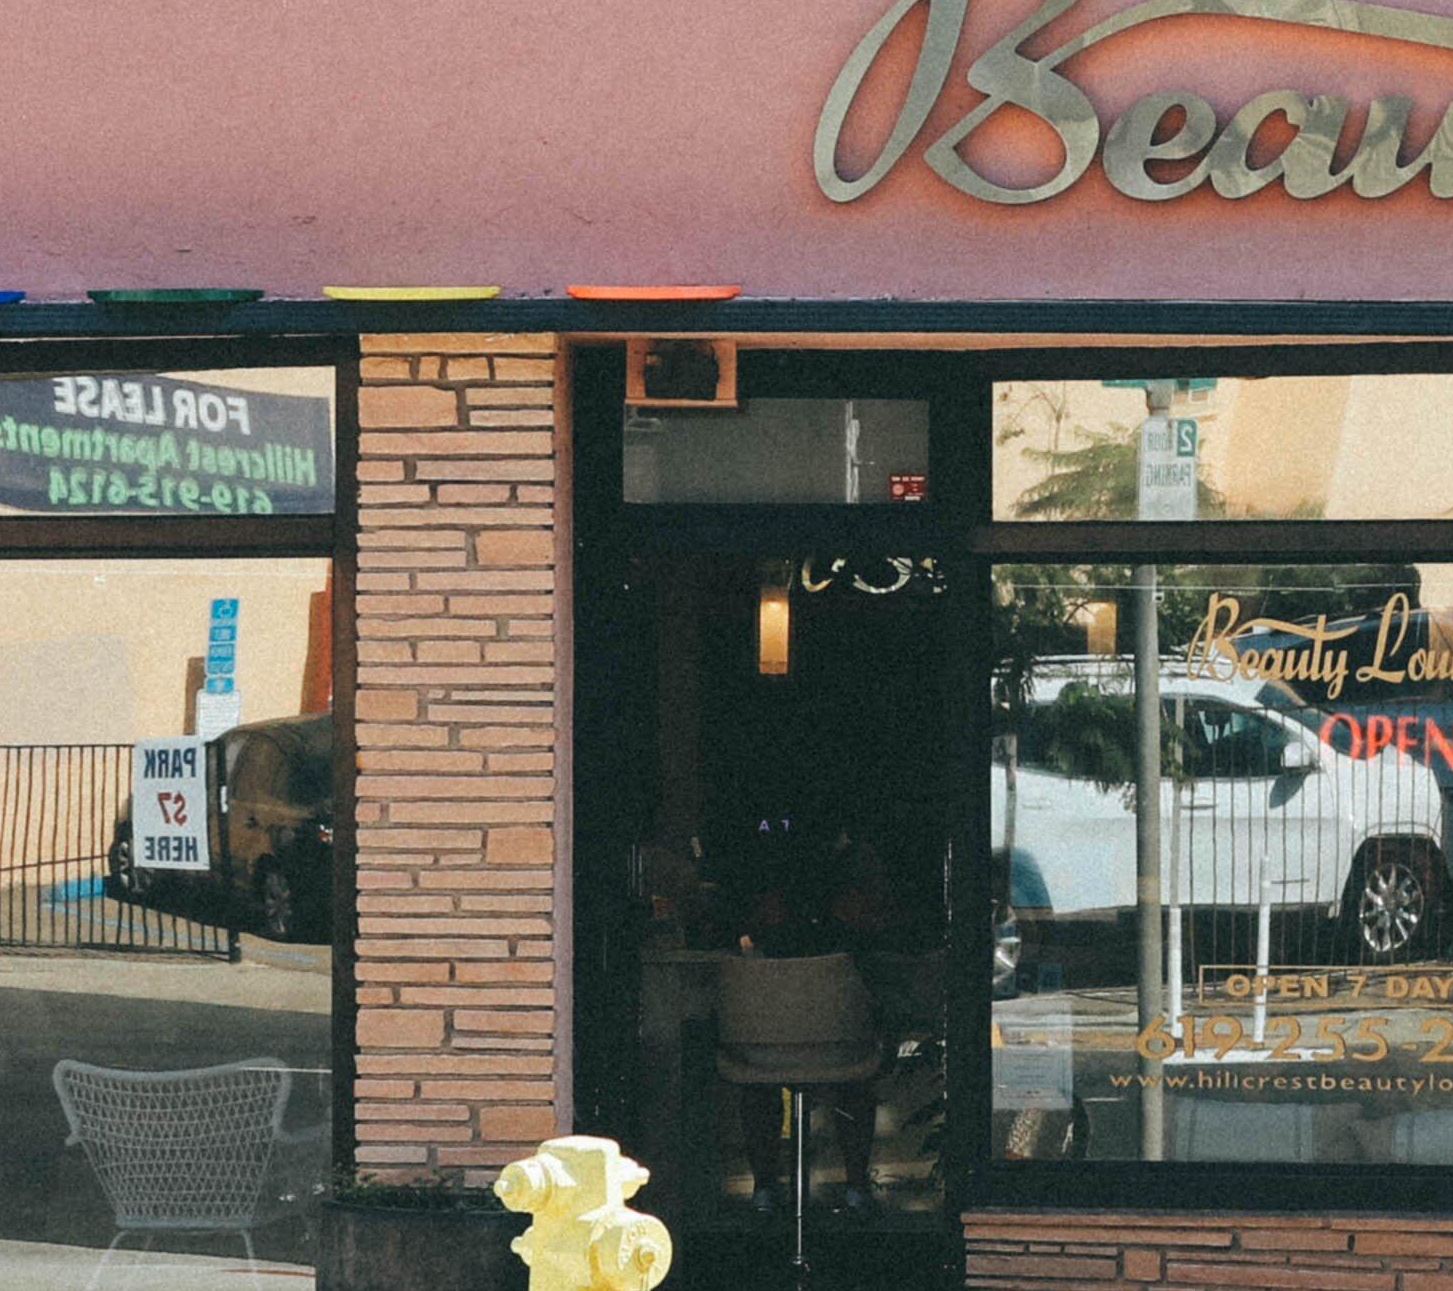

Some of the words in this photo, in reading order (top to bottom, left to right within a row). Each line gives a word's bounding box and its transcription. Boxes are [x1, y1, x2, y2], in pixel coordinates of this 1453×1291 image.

[1187, 591, 1359, 700] Beauty
[1226, 974, 1329, 999] OPEN
[1348, 975, 1362, 998] 7
